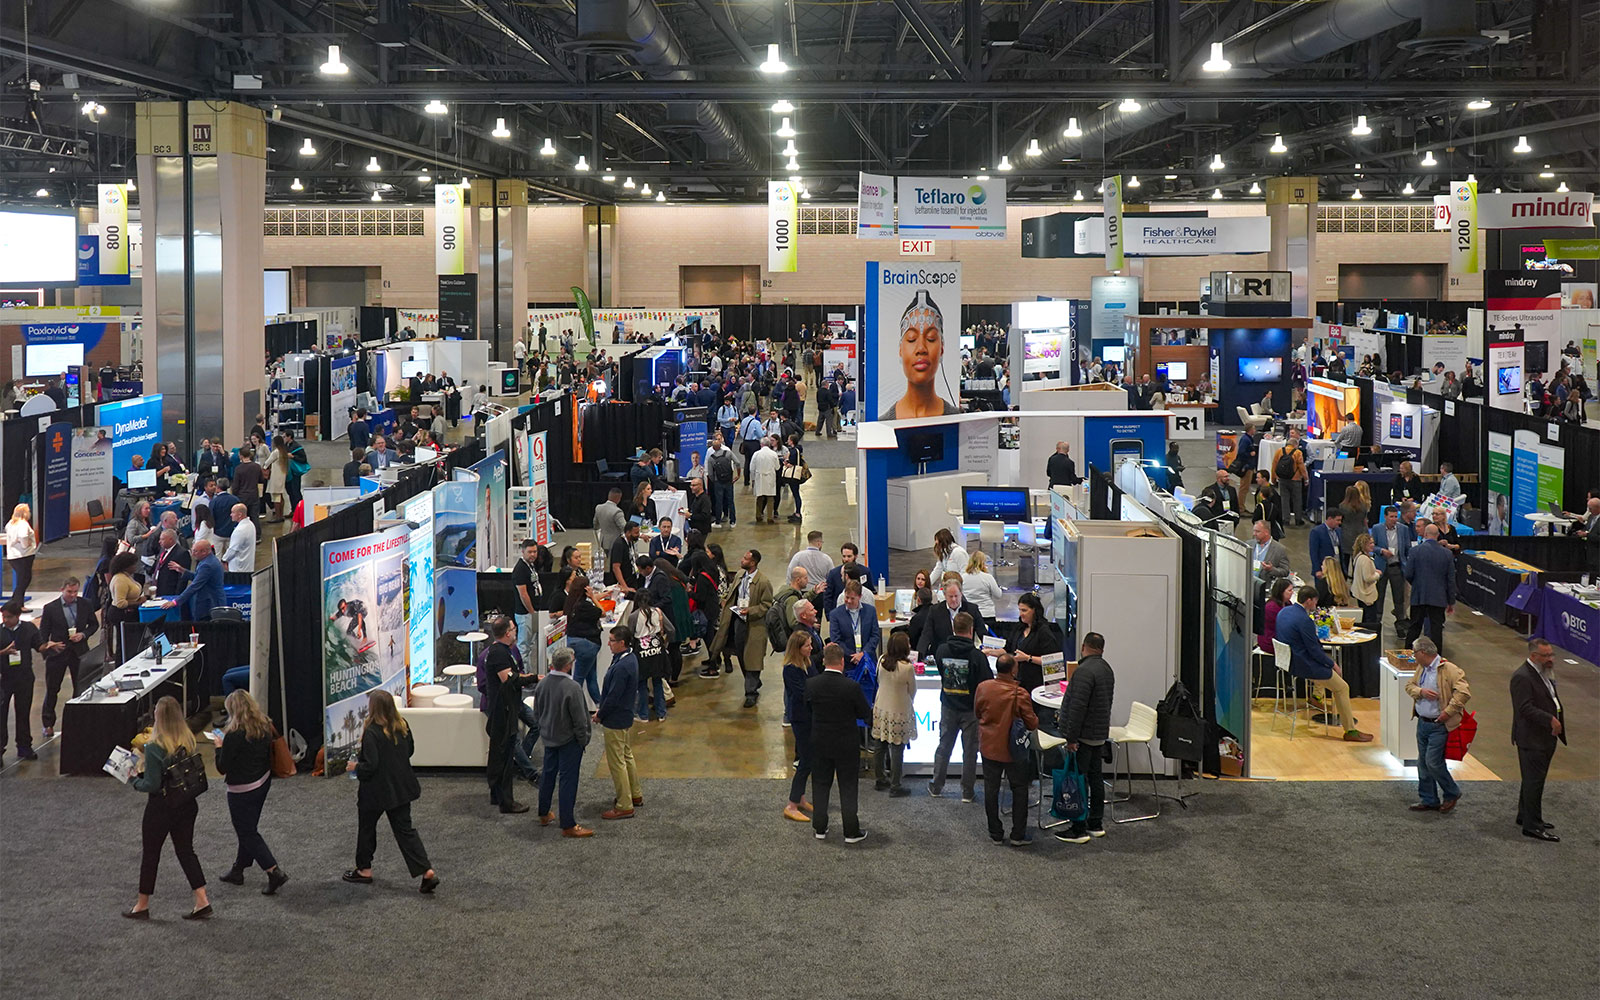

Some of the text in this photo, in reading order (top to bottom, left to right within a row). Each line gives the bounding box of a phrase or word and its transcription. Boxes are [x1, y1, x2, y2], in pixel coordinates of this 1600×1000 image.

[915, 188, 966, 204] Teflaro
[1512, 197, 1591, 222] mindray
[106, 226, 120, 250] 800
[443, 226, 456, 250] 900
[776, 220, 789, 251] 1000
[1108, 216, 1118, 248] 1100
[1458, 220, 1470, 252] 1200
[902, 240, 932, 252] EXIT
[883, 269, 956, 288] BrainScope
[1244, 278, 1272, 296] R1
[1504, 278, 1538, 288] mindray
[28, 326, 67, 336] Paxlovid
[115, 416, 148, 436] DynaMedex
[1176, 416, 1199, 430] R1
[329, 551, 356, 565] COME
[356, 546, 372, 558] FOR
[373, 542, 385, 554] THE
[1570, 616, 1586, 632] BTG
[330, 677, 358, 696] BEACH
